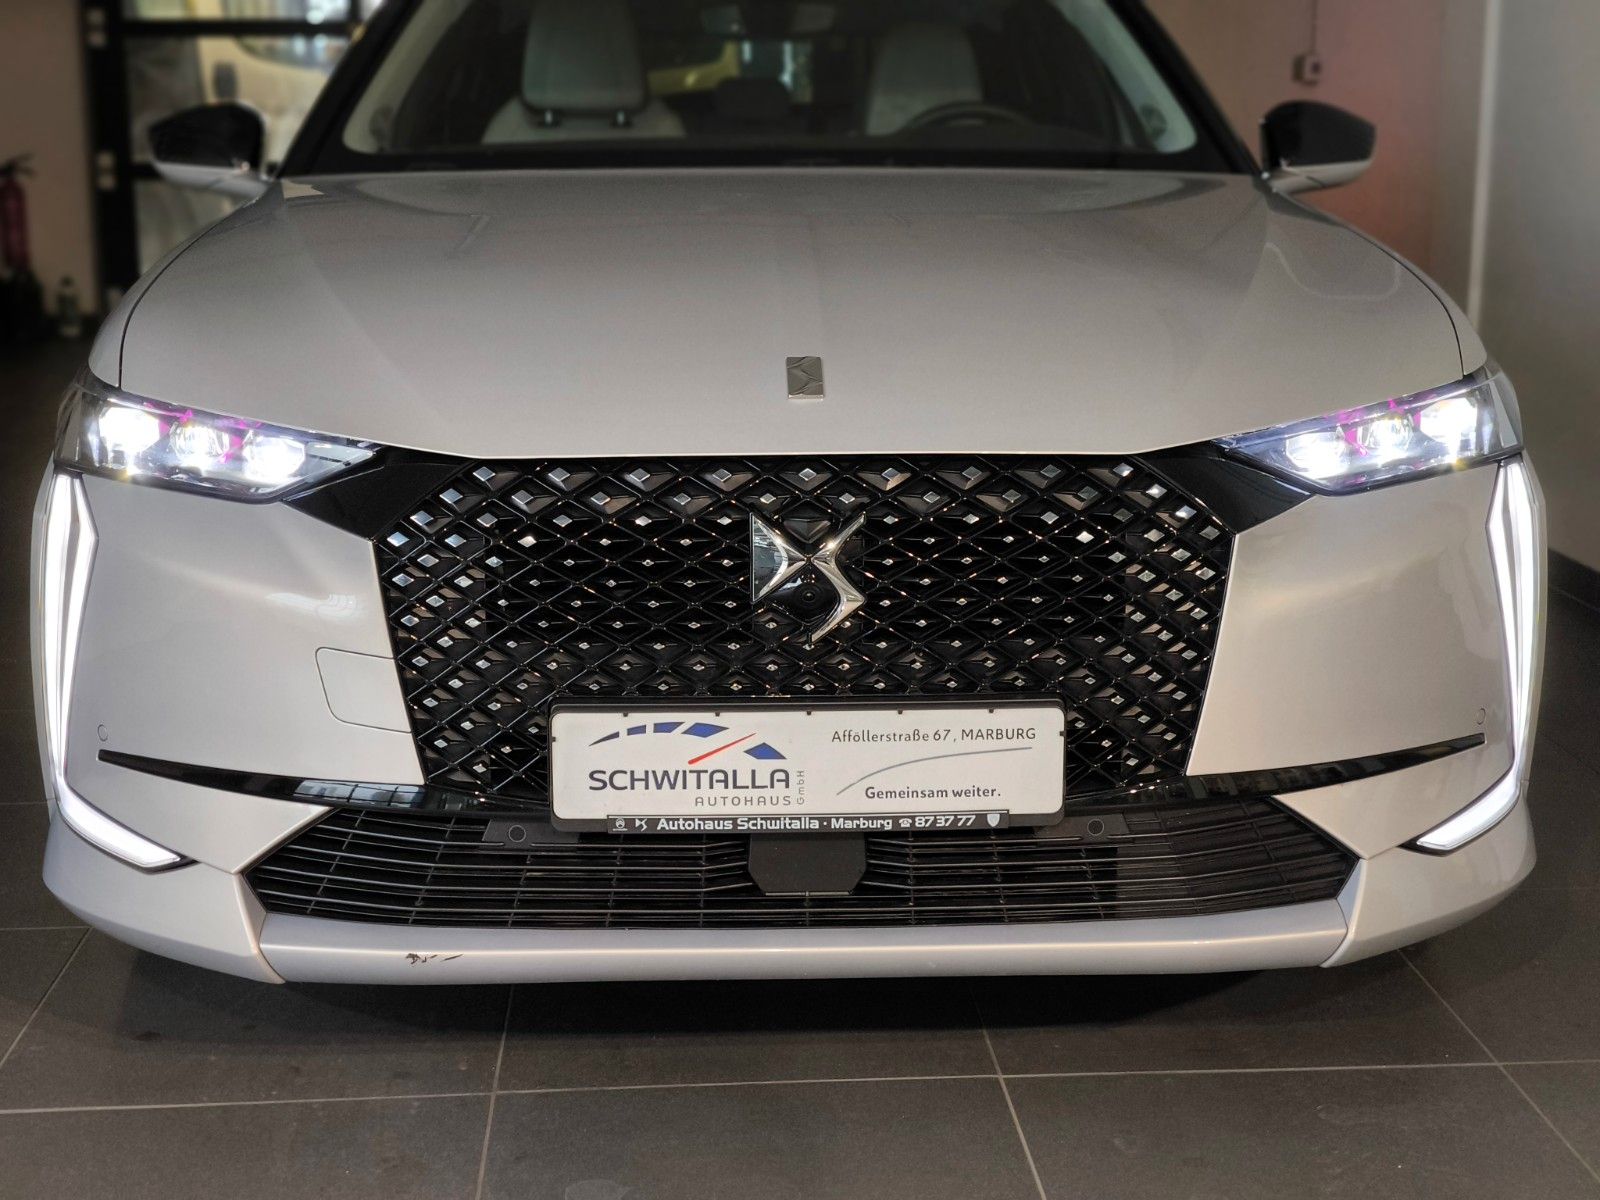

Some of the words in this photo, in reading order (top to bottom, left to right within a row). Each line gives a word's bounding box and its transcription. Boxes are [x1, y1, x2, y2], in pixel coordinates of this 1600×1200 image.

[831, 729, 929, 743] Afföllerstraße
[961, 727, 1036, 741] MARBURG
[588, 769, 790, 791] SCHWITALLA
[865, 786, 948, 800] Gemeinsam
[952, 786, 1001, 798] weiter.
[695, 795, 791, 807] AUTOHAUS
[656, 818, 733, 831] Autohaus
[737, 816, 820, 830] Schwitalla
[831, 817, 893, 830] Marburg
